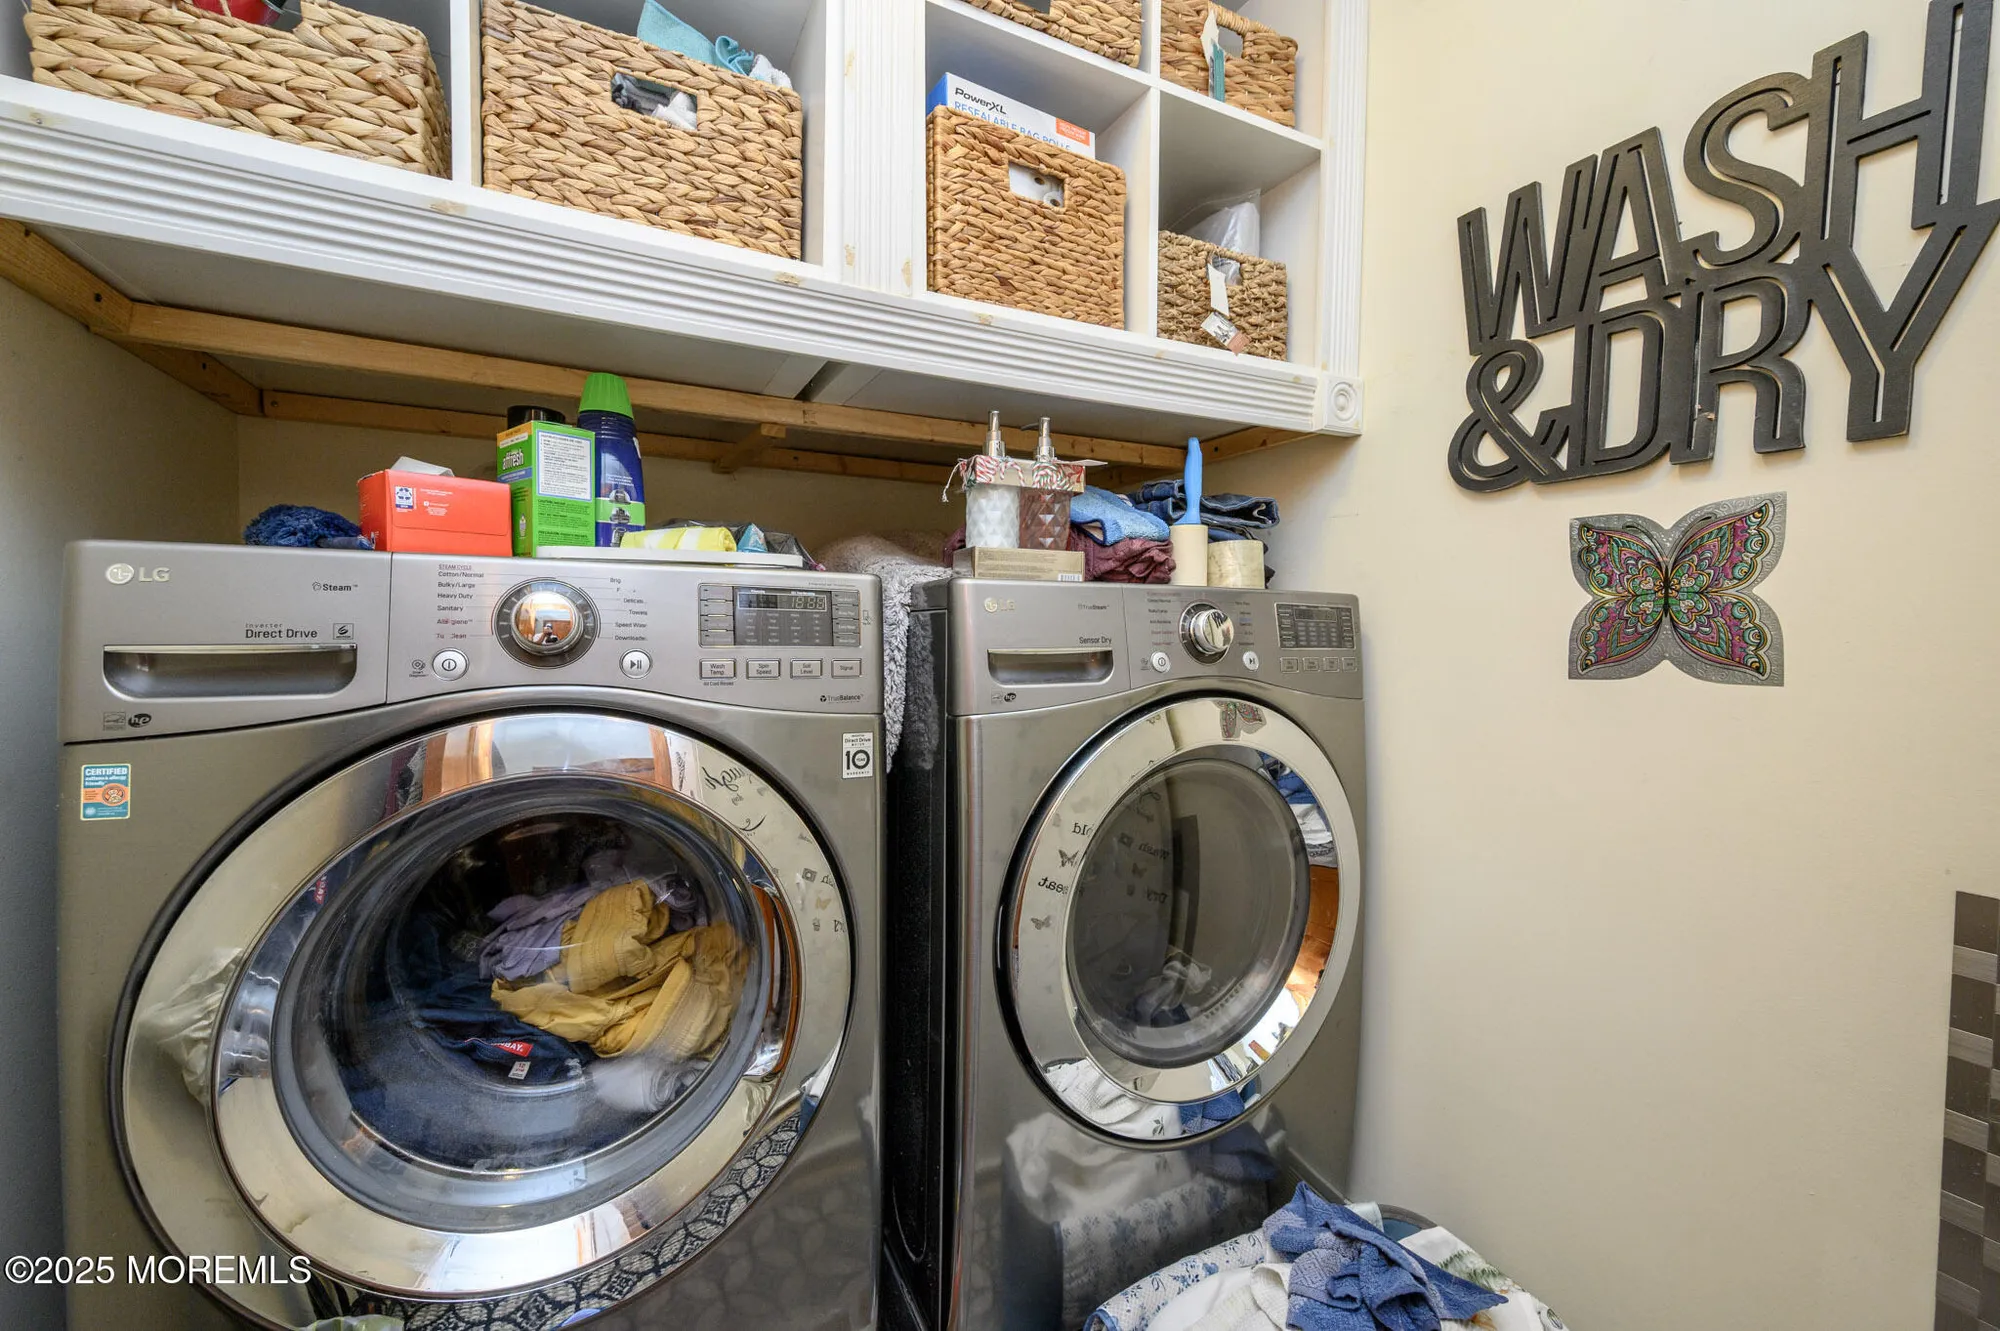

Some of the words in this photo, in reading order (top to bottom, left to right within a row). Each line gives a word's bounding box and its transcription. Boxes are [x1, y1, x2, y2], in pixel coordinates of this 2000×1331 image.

[954, 87, 1008, 115] PowerXL
[1457, 0, 1995, 356] WASH
[1448, 338, 1572, 492] &
[1566, 199, 2000, 482] DRY
[138, 566, 172, 582] LG
[245, 629, 283, 638] Direct
[286, 629, 318, 638] Drive
[1079, 636, 1100, 645] Sensor
[1101, 636, 1112, 645] Dry
[845, 749, 871, 770] 10
[85, 767, 128, 776] CERTIFIED
